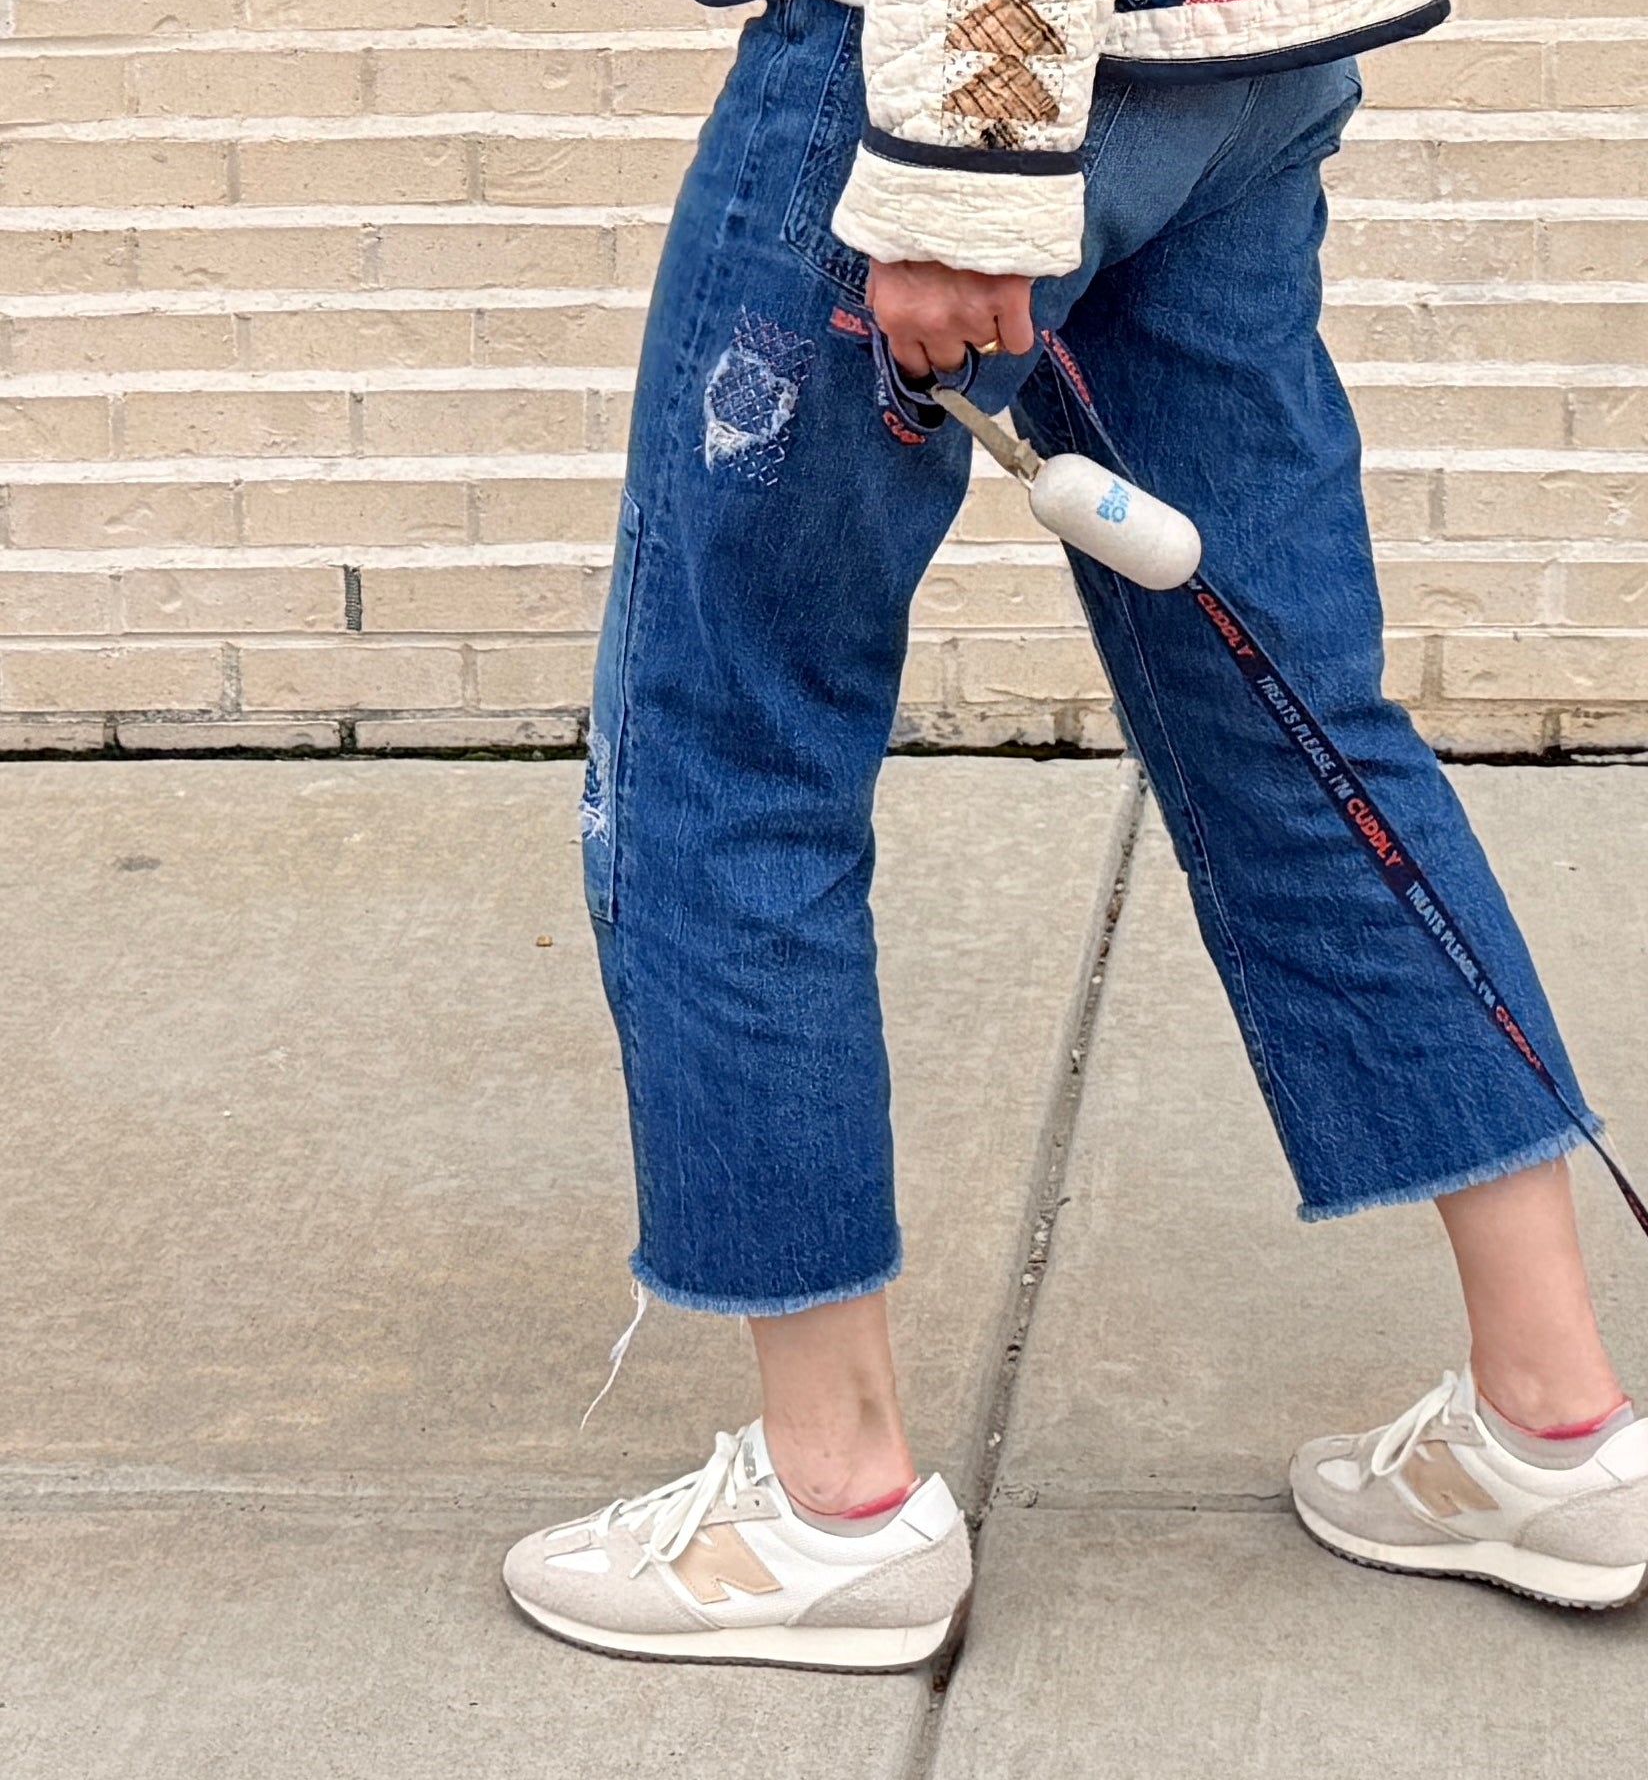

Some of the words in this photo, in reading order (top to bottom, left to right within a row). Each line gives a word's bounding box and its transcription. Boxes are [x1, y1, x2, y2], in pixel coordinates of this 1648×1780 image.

[1257, 675, 1302, 725] TREATS
[1346, 797, 1403, 868] CUDDLY
[1405, 880, 1447, 936] TREATS
